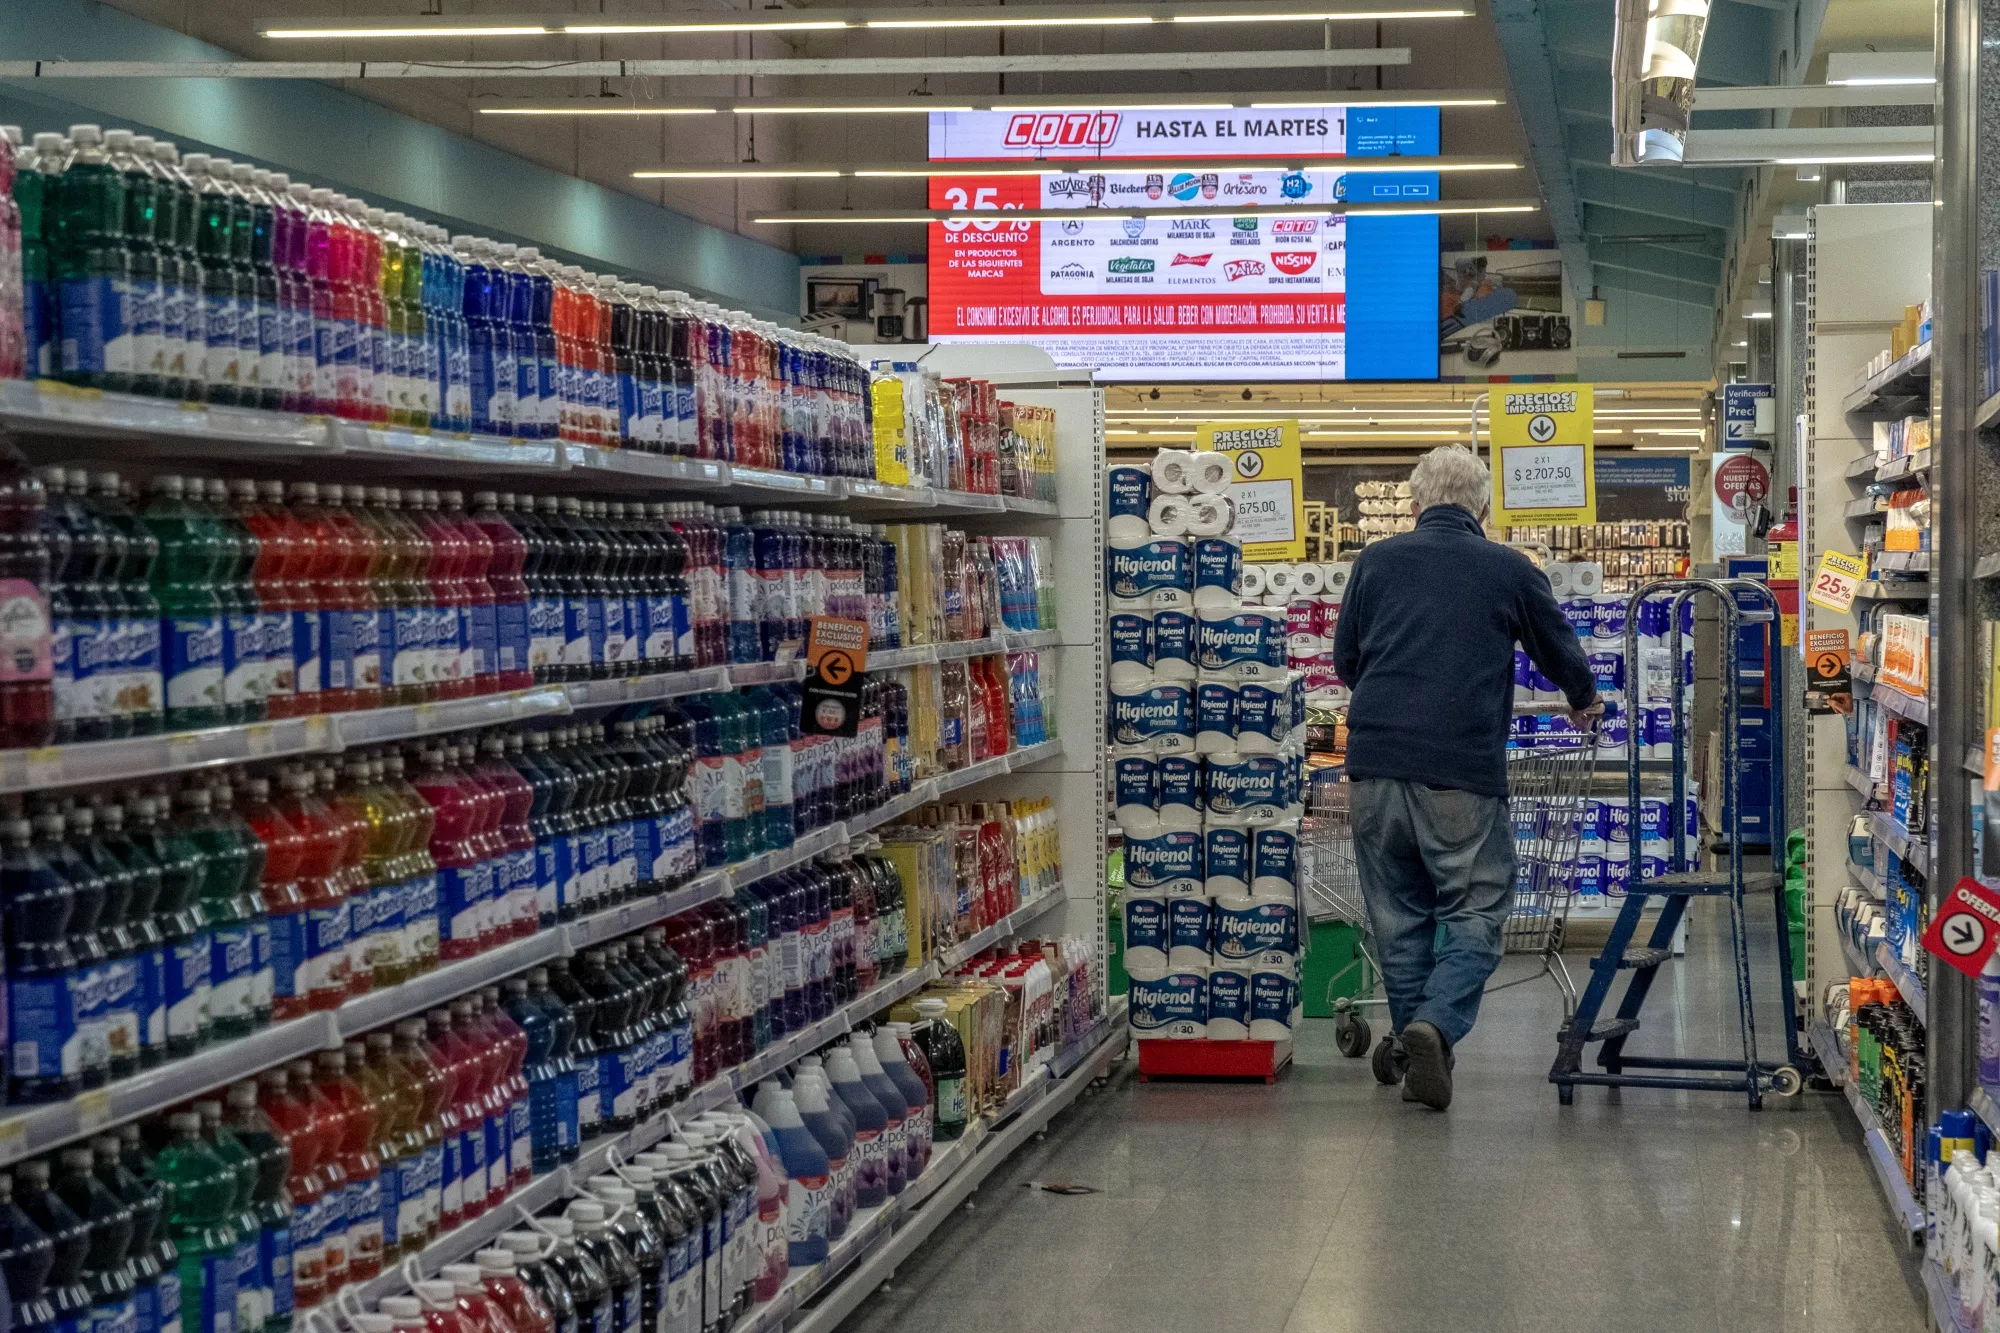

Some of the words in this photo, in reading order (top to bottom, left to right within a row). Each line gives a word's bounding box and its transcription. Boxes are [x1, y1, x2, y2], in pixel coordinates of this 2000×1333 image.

[1004, 113, 1119, 146] COTO
[1137, 120, 1207, 138] HASTA
[1215, 120, 1237, 137] EL
[1244, 119, 1328, 136] MARTES
[1224, 183, 1267, 195] Artesano
[942, 187, 1031, 232] 35%
[1273, 220, 1316, 232] COTO
[945, 232, 959, 243] DE
[962, 232, 1028, 243] DESCUENTO
[1166, 231, 1195, 239] MILANESAS
[1195, 231, 1202, 239] DE
[1203, 231, 1215, 239] SOJA
[1231, 231, 1259, 239] VEGETALES
[1305, 235, 1312, 243] ML
[1051, 239, 1095, 247] ARGENTO
[1110, 238, 1139, 246] SALCHICHAS
[1140, 238, 1159, 246] CORTAS
[1230, 238, 1261, 246] CONGELADOS
[954, 249, 965, 257] EN
[967, 249, 1017, 257] PRODUCTOS
[948, 260, 959, 268] DE
[961, 259, 976, 268] LAS
[978, 259, 1022, 268] SIGUIENTES
[967, 269, 1004, 278] MARCAS
[1051, 270, 1095, 279] PATAGONIA
[1106, 275, 1134, 283] MILANESAS
[1134, 275, 1138, 283] DE
[1138, 275, 1154, 283] SOJA
[1168, 277, 1216, 285] ELEMENTOS
[957, 307, 965, 327] EL
[966, 306, 997, 327] CONSUMO
[998, 306, 1030, 326] EXCESIVO
[1031, 306, 1040, 326] DE
[1042, 306, 1070, 326] ALCOHOL
[1072, 306, 1081, 325] ES
[1082, 305, 1122, 326] PERJUDICIAL
[1124, 306, 1142, 325] PARA
[1143, 306, 1151, 325] LA
[1153, 305, 1176, 325] SALUD.
[1178, 305, 1199, 325] BEBER
[1201, 305, 1215, 325] CON
[1260, 304, 1295, 324] PROHIBIDA
[1296, 304, 1306, 324] SU
[1307, 304, 1328, 324] VENTA
[1329, 304, 1335, 323] A
[1728, 389, 1770, 398] Verificador
[1505, 392, 1570, 406] PRECIOS
[1728, 398, 1738, 406] de
[1728, 406, 1755, 417] Preci
[1212, 428, 1276, 443] PRECIOS
[1514, 468, 1522, 481] $
[1525, 466, 1571, 481] 2.707,50
[1723, 474, 1761, 482] NUESTRAS
[1113, 483, 1141, 492] Higienol
[1723, 482, 1761, 490] OFERTAS
[1241, 491, 1246, 499] 2
[1237, 500, 1276, 515] .675,00
[1114, 555, 1177, 574] Higienol
[1826, 554, 1862, 570] PRECIOS
[1817, 573, 1851, 600] 25%
[1822, 591, 1849, 606] DESCUENTO
[1288, 610, 1311, 622] enol
[817, 621, 864, 634] BENEFICIO
[1157, 626, 1185, 636] Higienol
[816, 630, 863, 643] EXCLUSIVO
[1113, 629, 1142, 639] Higienol
[1201, 627, 1261, 648] Higienol
[1809, 632, 1845, 641] BENEFICIO
[814, 639, 862, 650] COMUNIDAD
[1809, 639, 1845, 647] EXCLUSIVO
[1810, 645, 1846, 653] COMUNIDAD
[1295, 661, 1335, 678] Higieno
[1590, 660, 1617, 674] enol
[1200, 699, 1229, 709] Higienol
[1241, 700, 1267, 710] Higienol
[1116, 700, 1178, 722] Higienol
[1120, 773, 1149, 782] Higienol
[1211, 770, 1275, 792] Higienol
[1609, 807, 1661, 824] Hignol
[1212, 844, 1240, 854] Higienol
[1130, 845, 1193, 864] Higienol
[1131, 914, 1159, 924] Higienol
[1221, 918, 1286, 939] Higienol
[1212, 986, 1240, 996] Higienol
[1133, 987, 1195, 1006] Higienol
